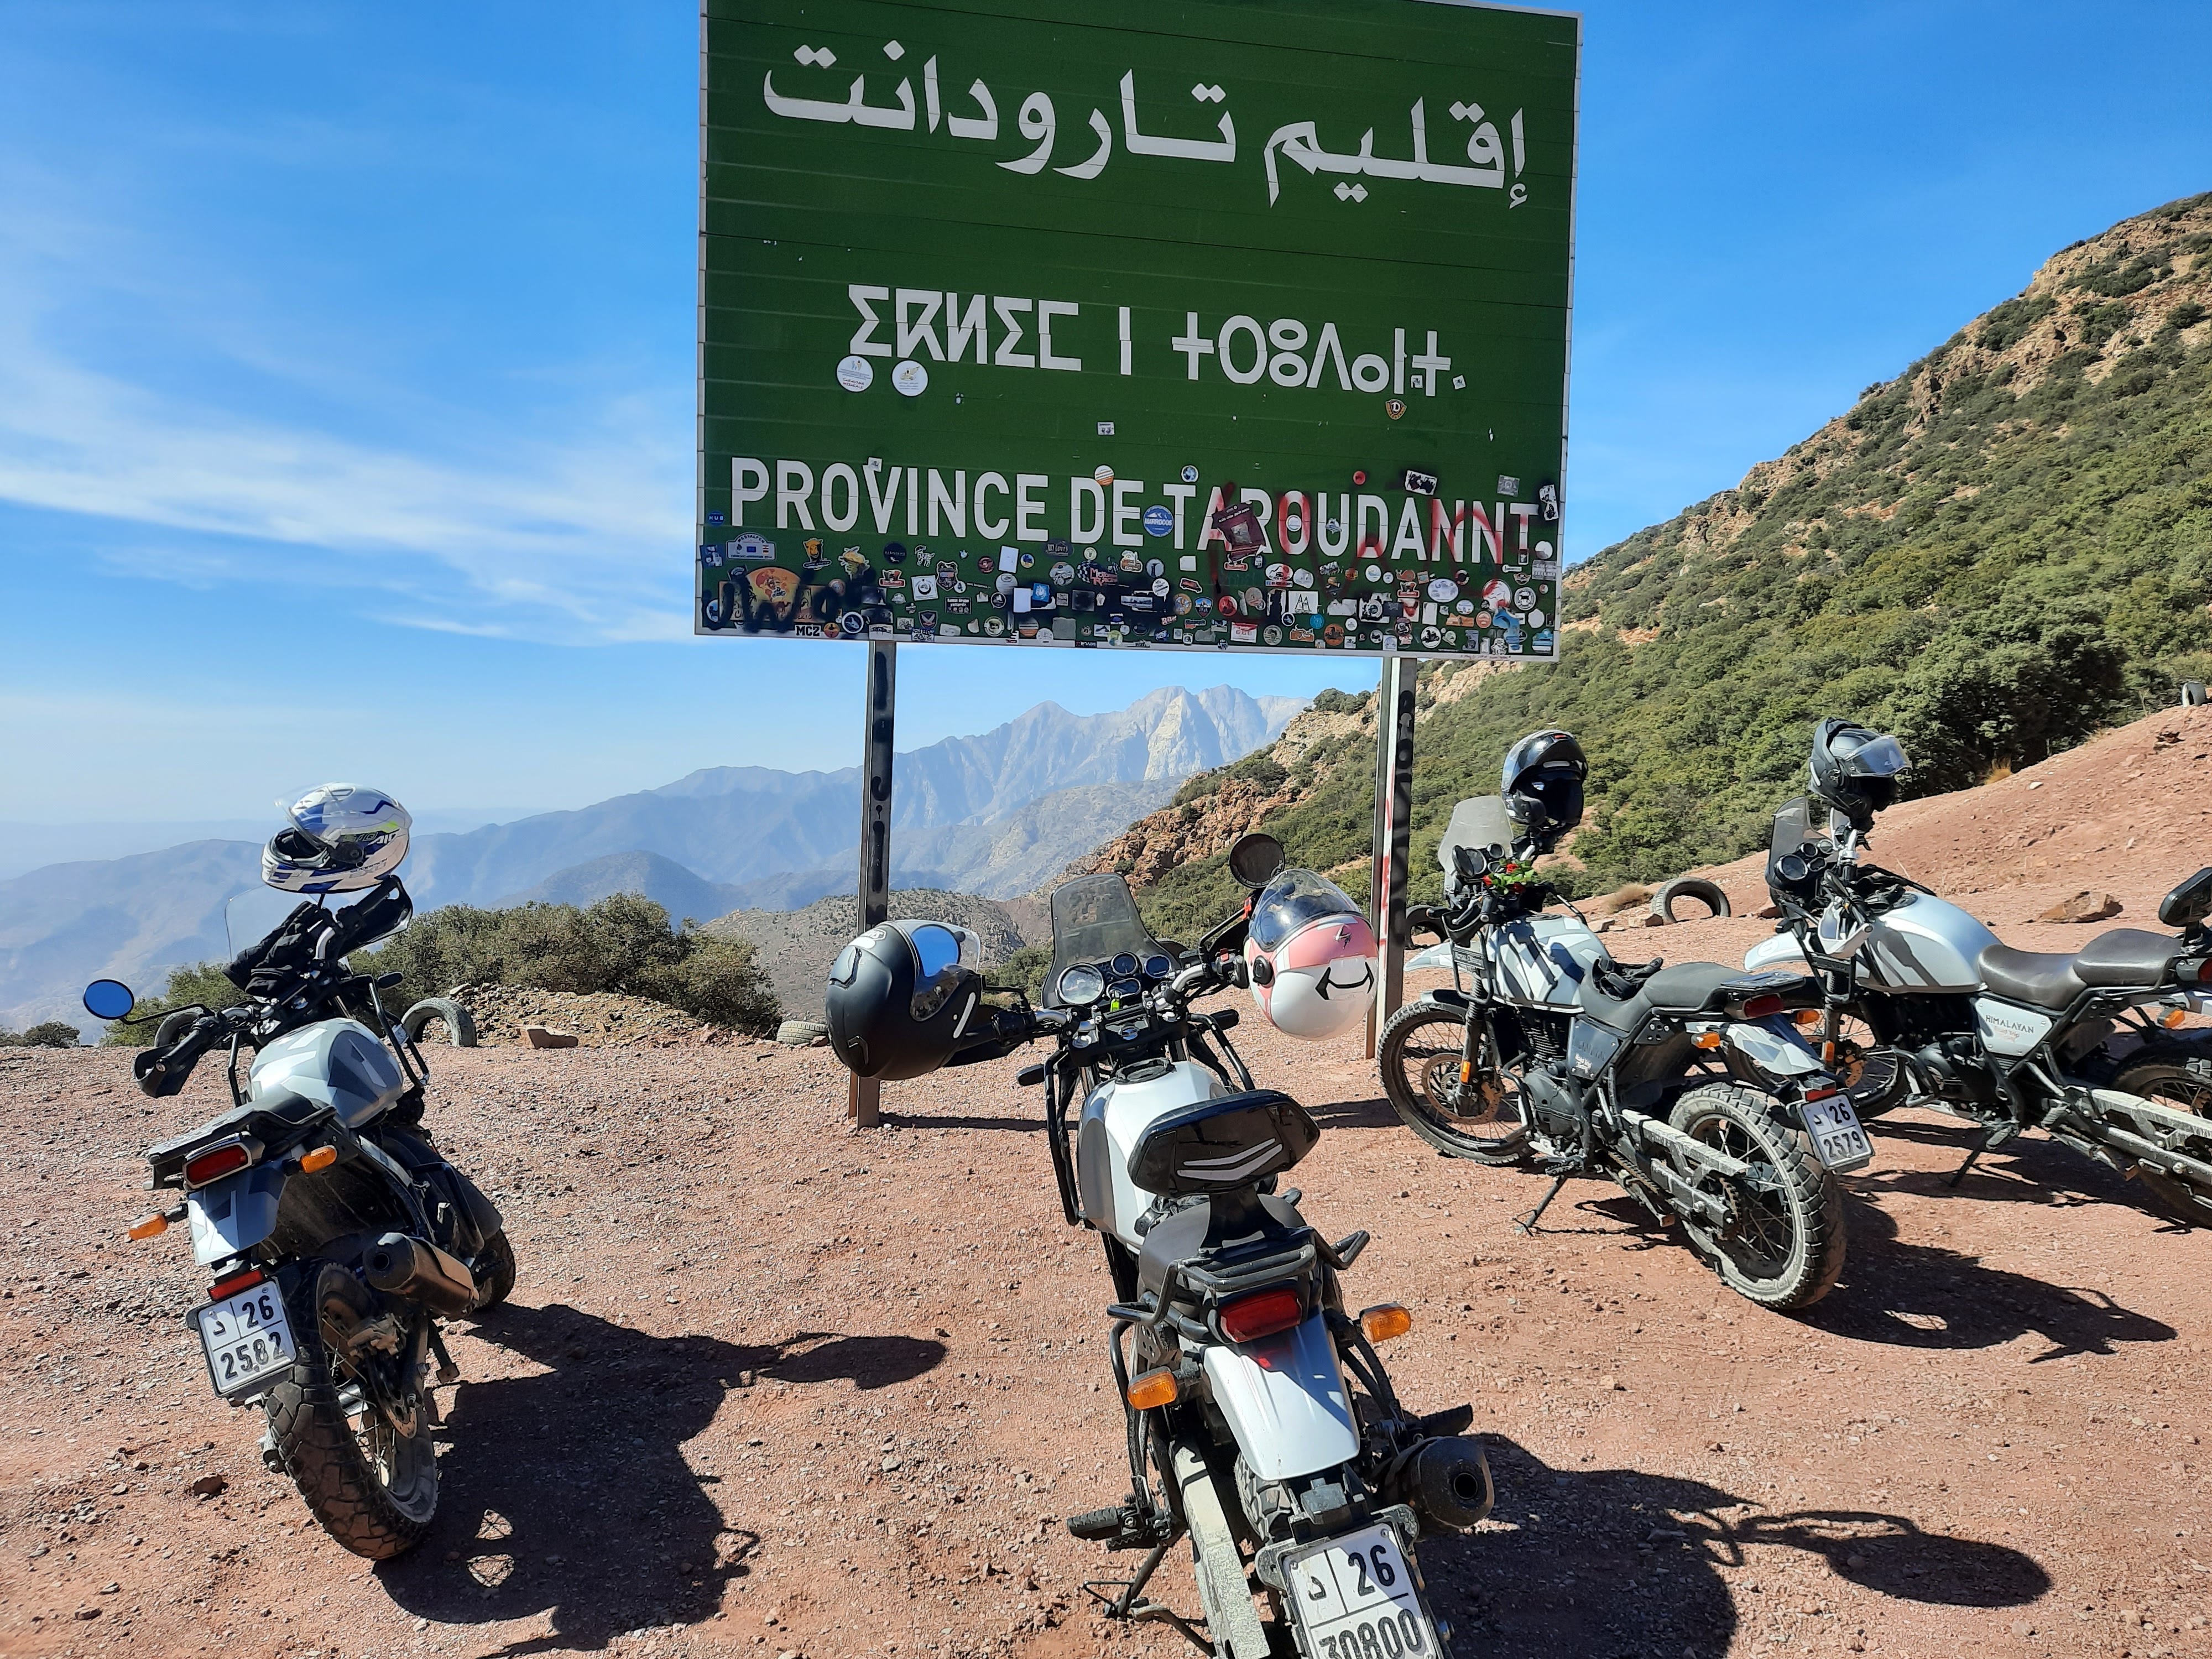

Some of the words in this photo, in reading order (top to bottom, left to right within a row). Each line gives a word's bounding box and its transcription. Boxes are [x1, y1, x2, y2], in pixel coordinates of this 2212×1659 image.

[764, 40, 1236, 180] تارودانت
[1264, 96, 1527, 209] إقليم
[732, 457, 1048, 542] PROVINCE
[1071, 477, 1144, 546] DE
[1164, 483, 1539, 564] TAROUDANNT
[796, 625, 820, 637] MCZ
[1985, 1014, 2034, 1034] HIMALAYAN
[1829, 1103, 1851, 1124] 26
[1823, 1130, 1863, 1159] 2579
[242, 1295, 274, 1329] 26
[220, 1332, 285, 1380] 2582
[1348, 1545, 1395, 1597] 26
[1318, 1609, 1424, 1659] 30800
